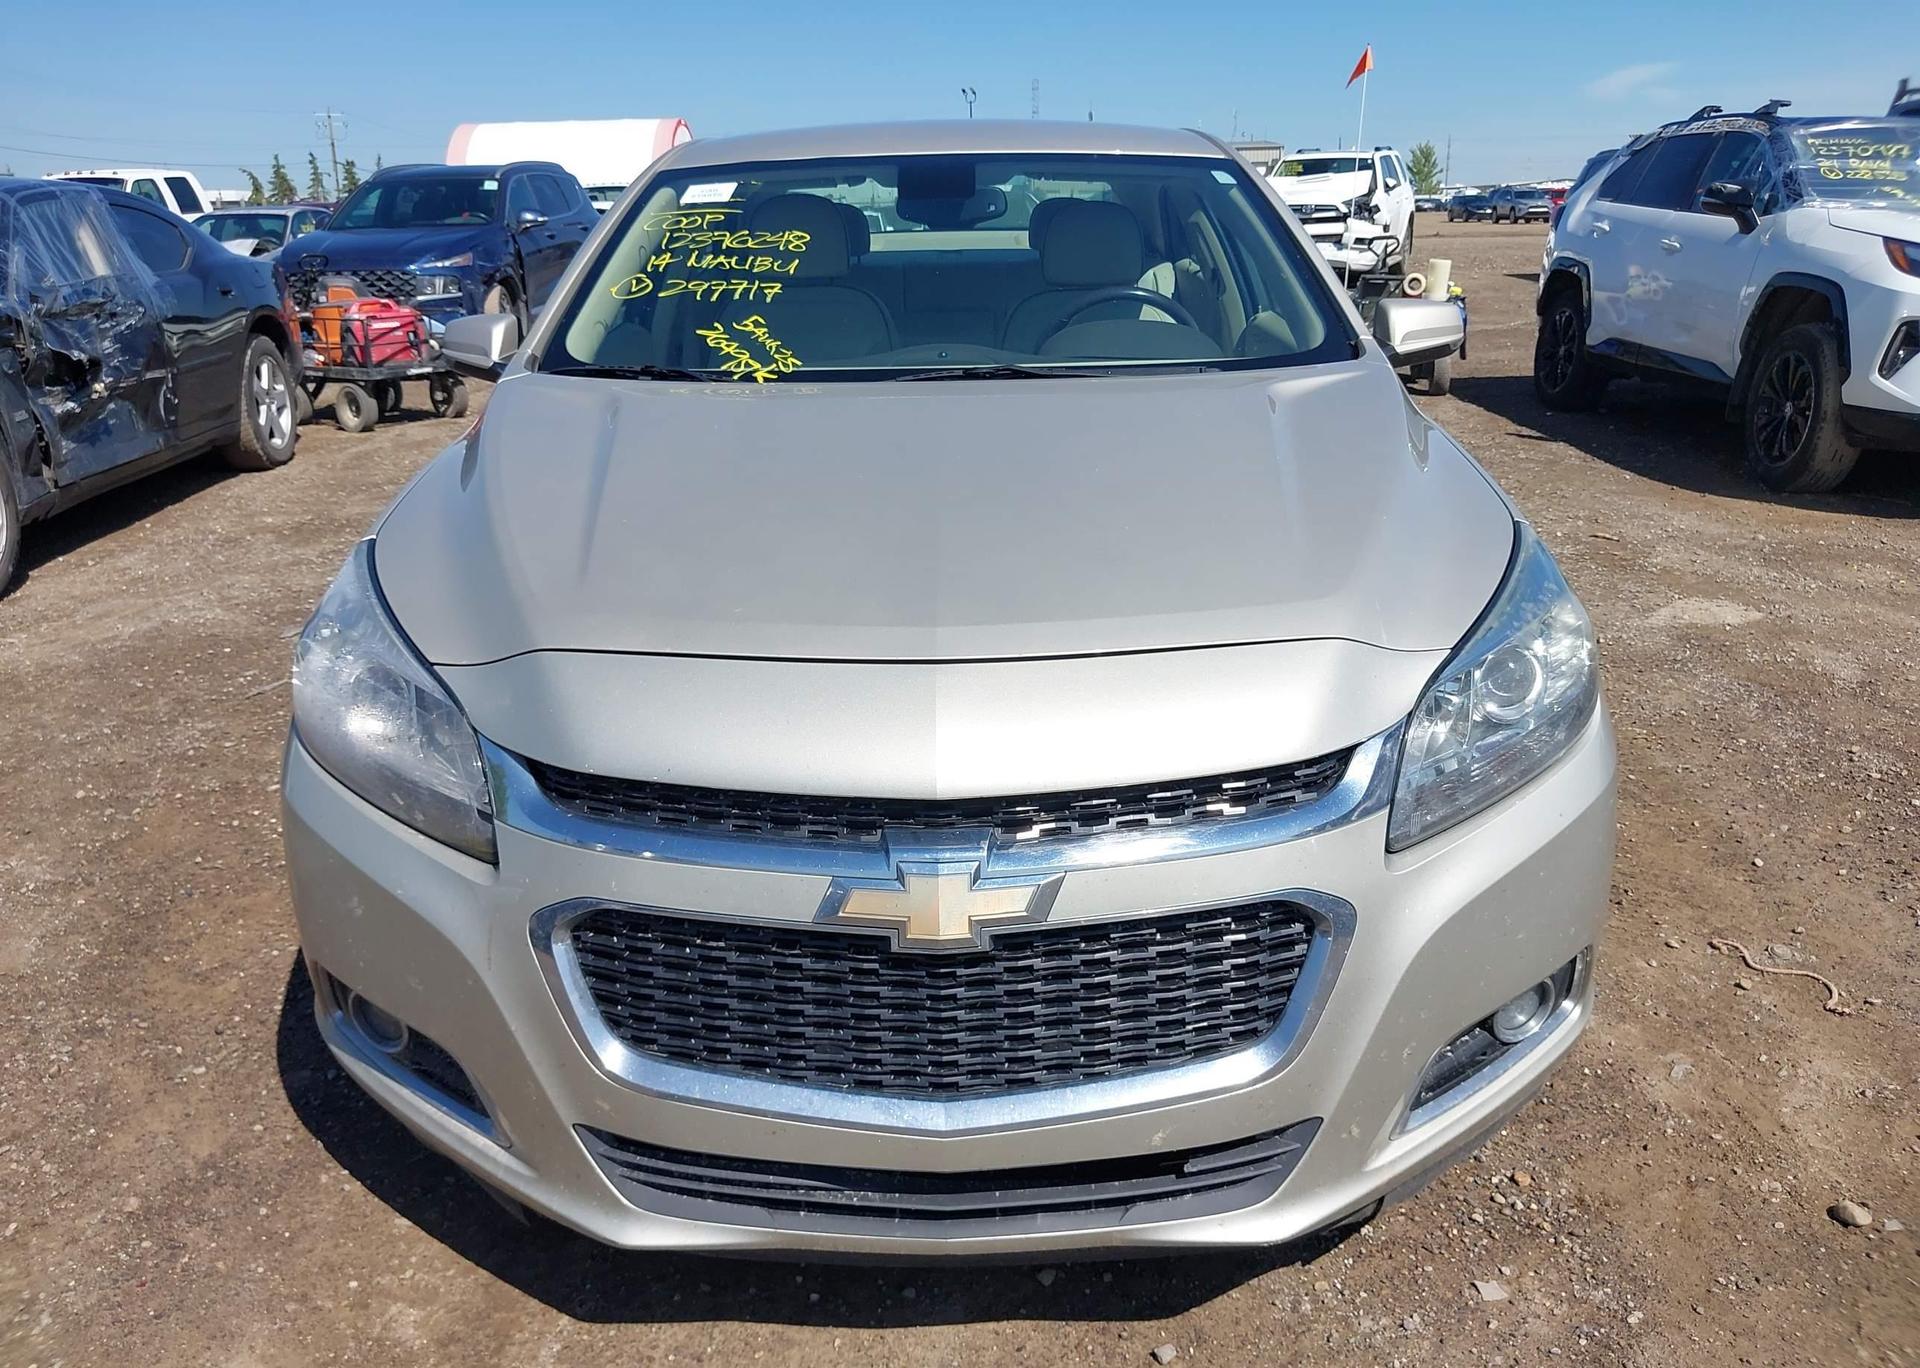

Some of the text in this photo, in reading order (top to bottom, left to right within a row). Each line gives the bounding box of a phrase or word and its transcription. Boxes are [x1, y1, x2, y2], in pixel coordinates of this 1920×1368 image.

[643, 214, 725, 230] COOP
[661, 230, 811, 252] 12376248
[647, 250, 800, 276] 14 MALIBU
